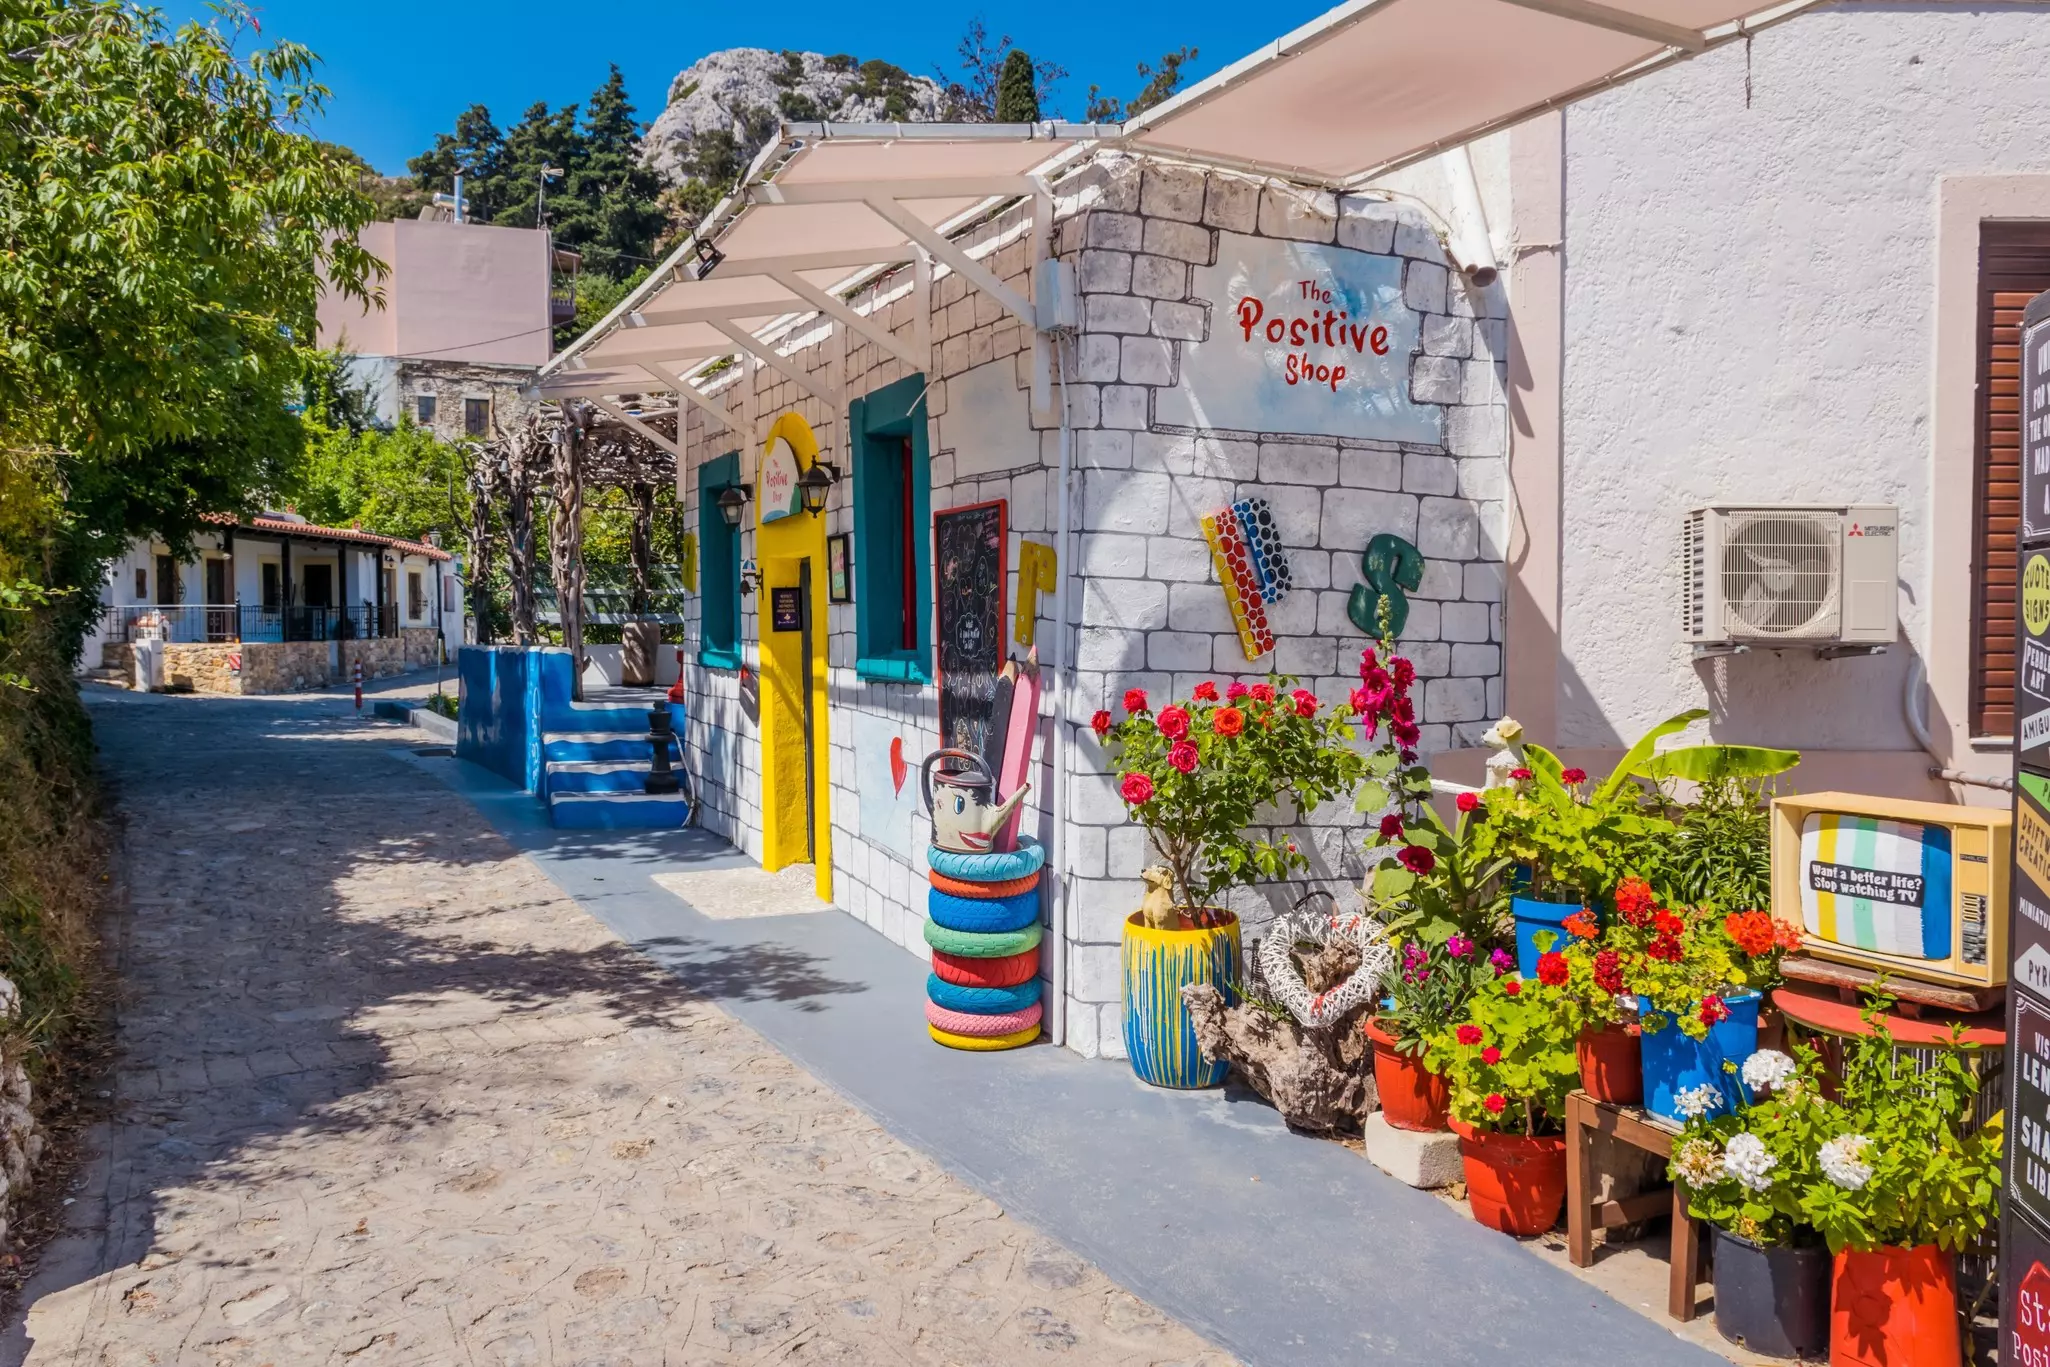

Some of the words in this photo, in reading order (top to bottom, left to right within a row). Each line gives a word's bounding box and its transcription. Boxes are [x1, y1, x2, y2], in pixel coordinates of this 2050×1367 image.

[1298, 280, 1332, 304] The
[1237, 296, 1389, 355] Positive
[1285, 353, 1346, 392] Shop
[2030, 417, 2041, 442] THE
[2025, 564, 2050, 590] QUOTE
[2025, 599, 2050, 623] SIGNS
[2030, 669, 2046, 692] ART
[1812, 864, 1838, 879] Want
[1840, 871, 1847, 880] a
[1850, 870, 1888, 887] better
[1891, 875, 1922, 890] life?
[1814, 877, 1838, 892] Stop
[1840, 882, 1895, 901] watching
[1898, 889, 1918, 902] TV
[2028, 959, 2050, 988] PYR
[2021, 1290, 2050, 1332] St
